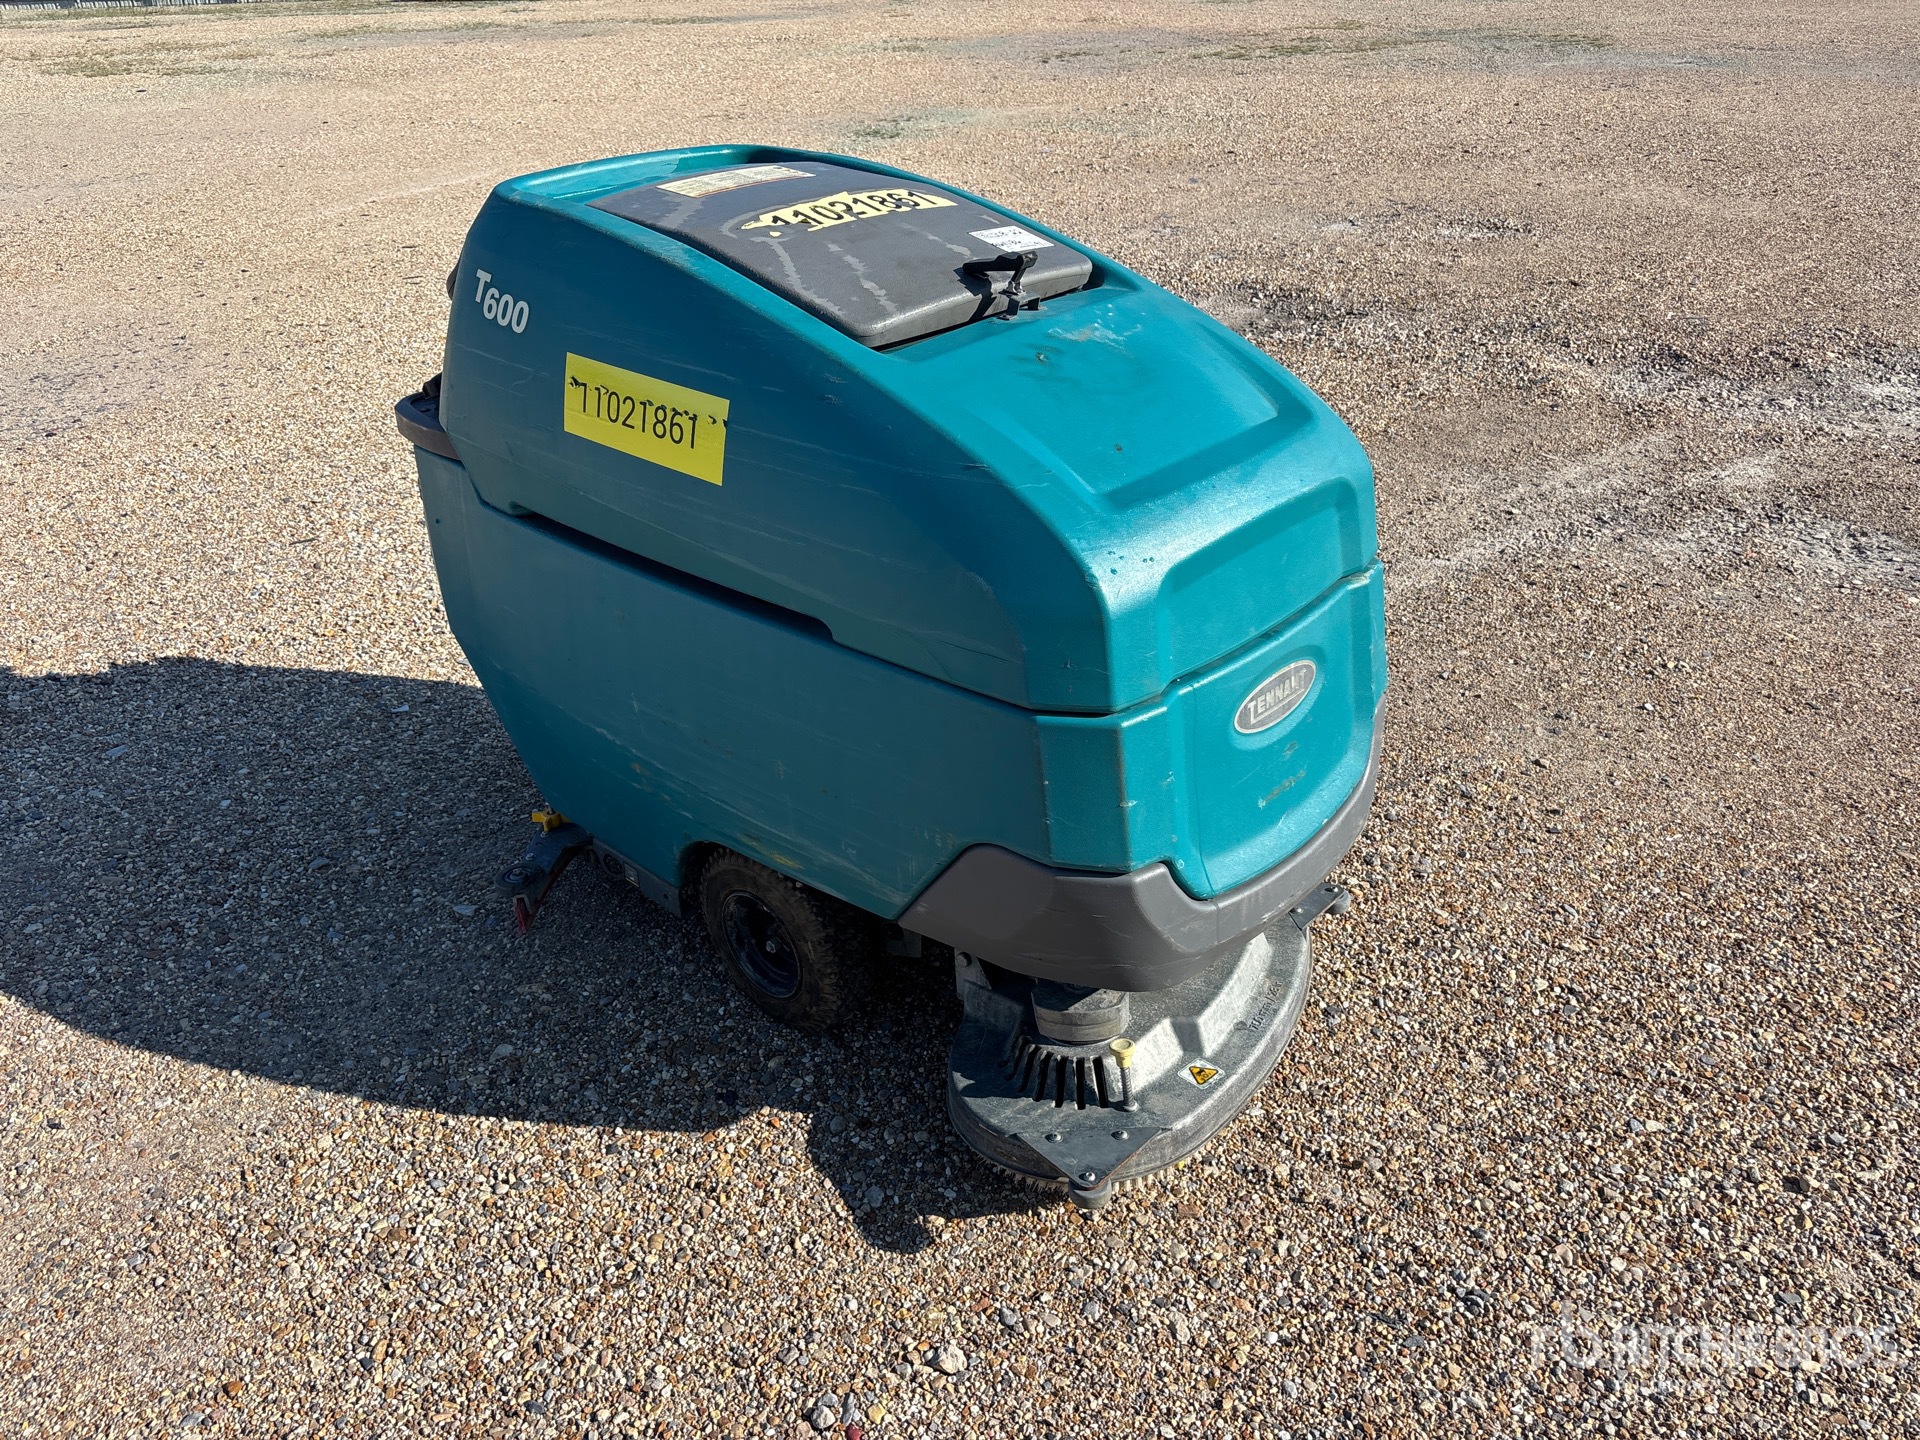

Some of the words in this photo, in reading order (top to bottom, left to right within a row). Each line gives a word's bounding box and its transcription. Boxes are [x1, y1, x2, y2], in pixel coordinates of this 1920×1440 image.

[475, 268, 529, 334] T600
[576, 382, 698, 450] 11021861
[1247, 667, 1307, 725] TENNANT
